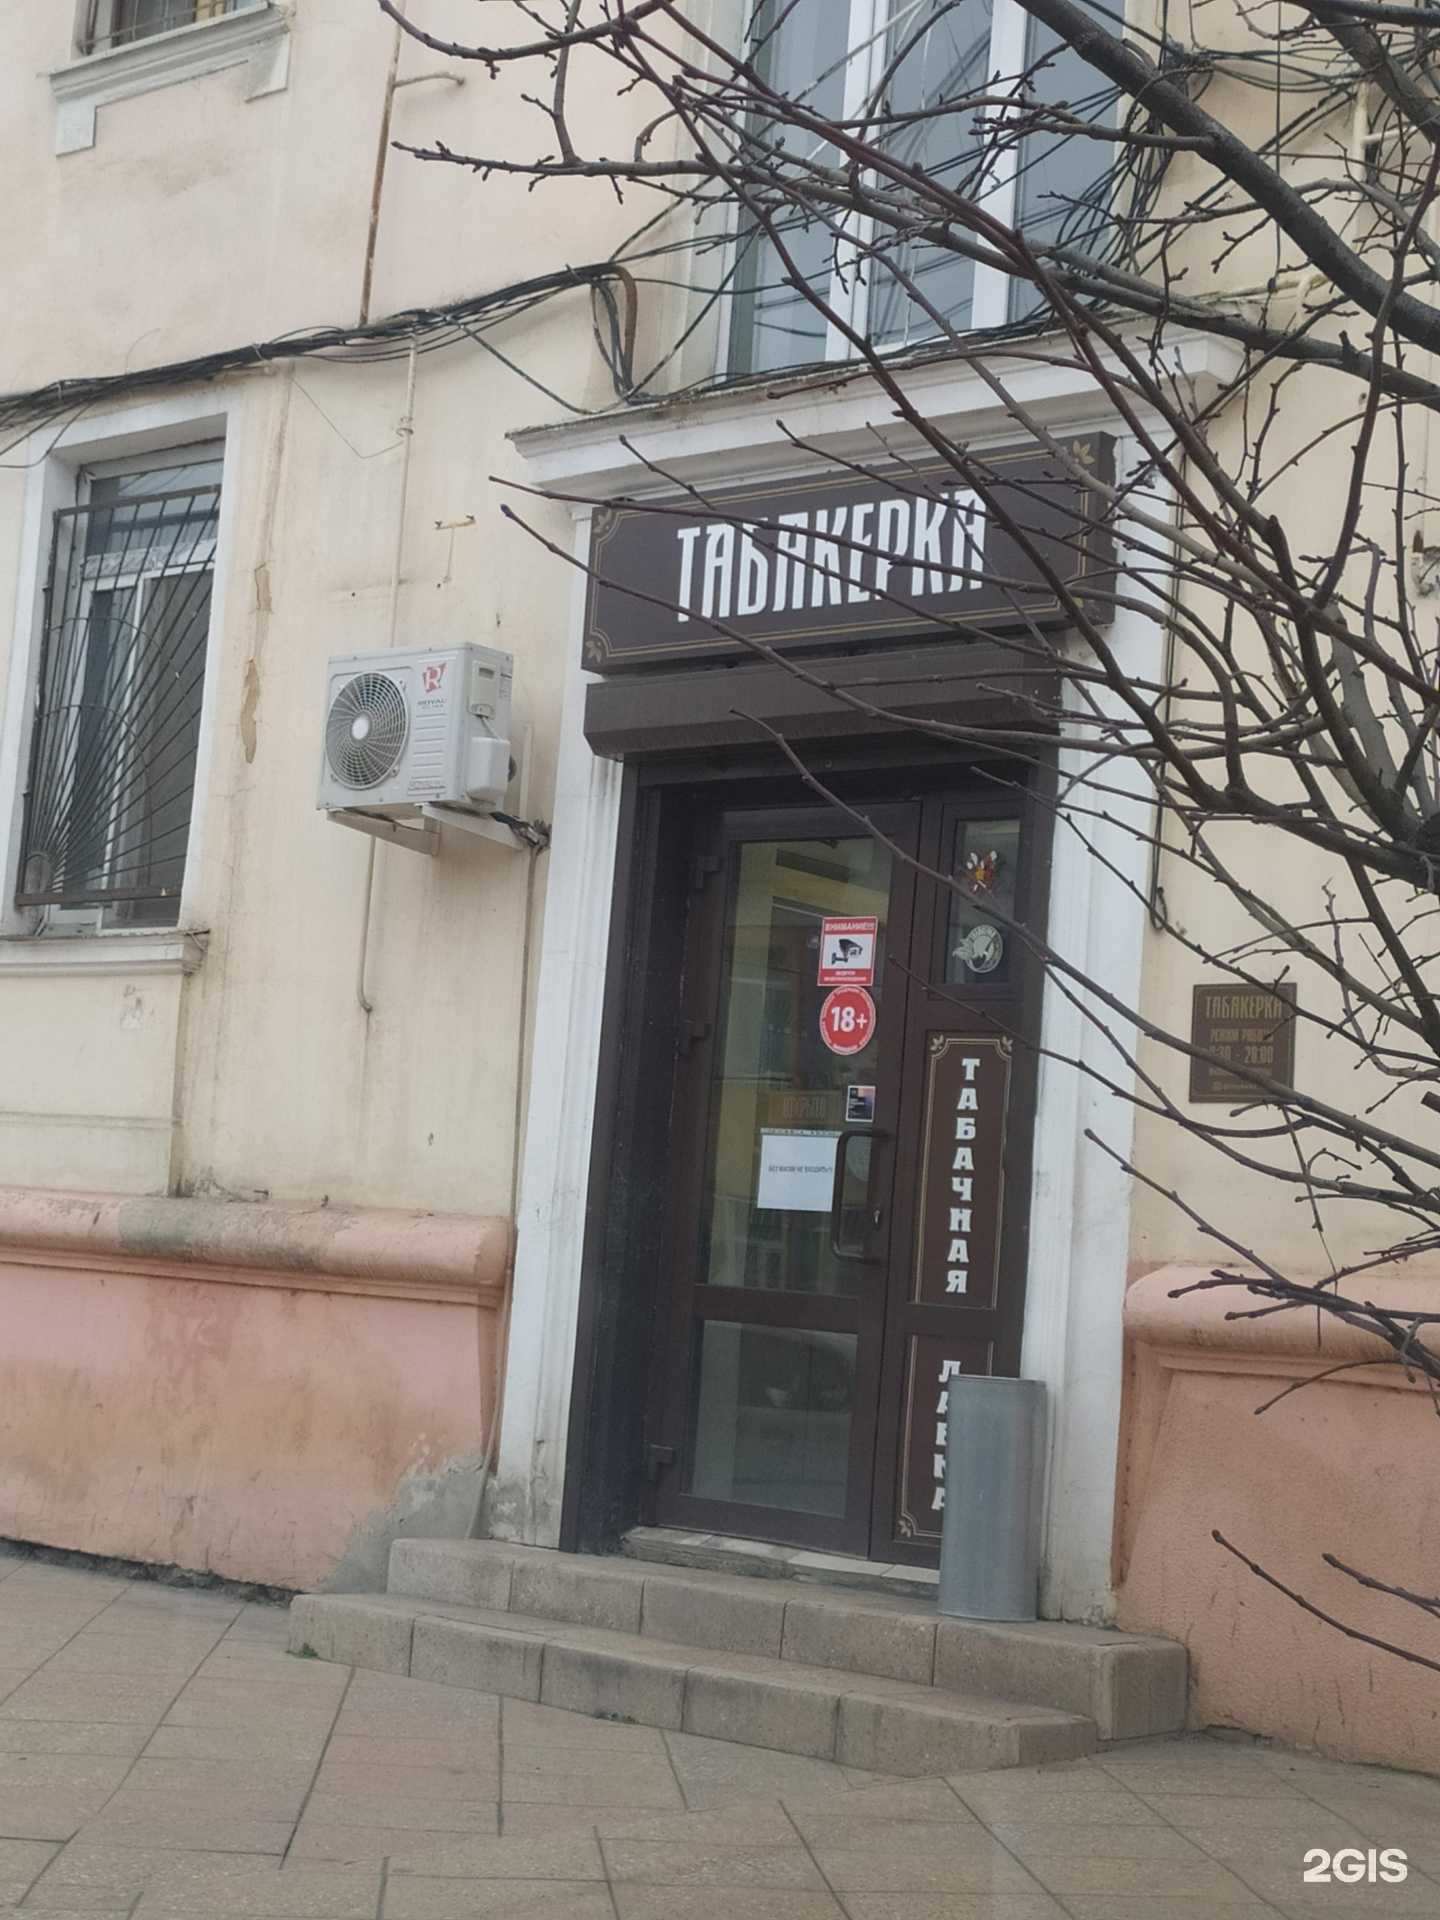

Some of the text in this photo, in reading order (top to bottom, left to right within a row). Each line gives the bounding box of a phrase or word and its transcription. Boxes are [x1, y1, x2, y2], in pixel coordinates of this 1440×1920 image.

[677, 488, 987, 623] ТАБАКЕРКА
[831, 1006, 868, 1033] 18+
[945, 1058, 981, 1293] ТАБАЧНАЯ
